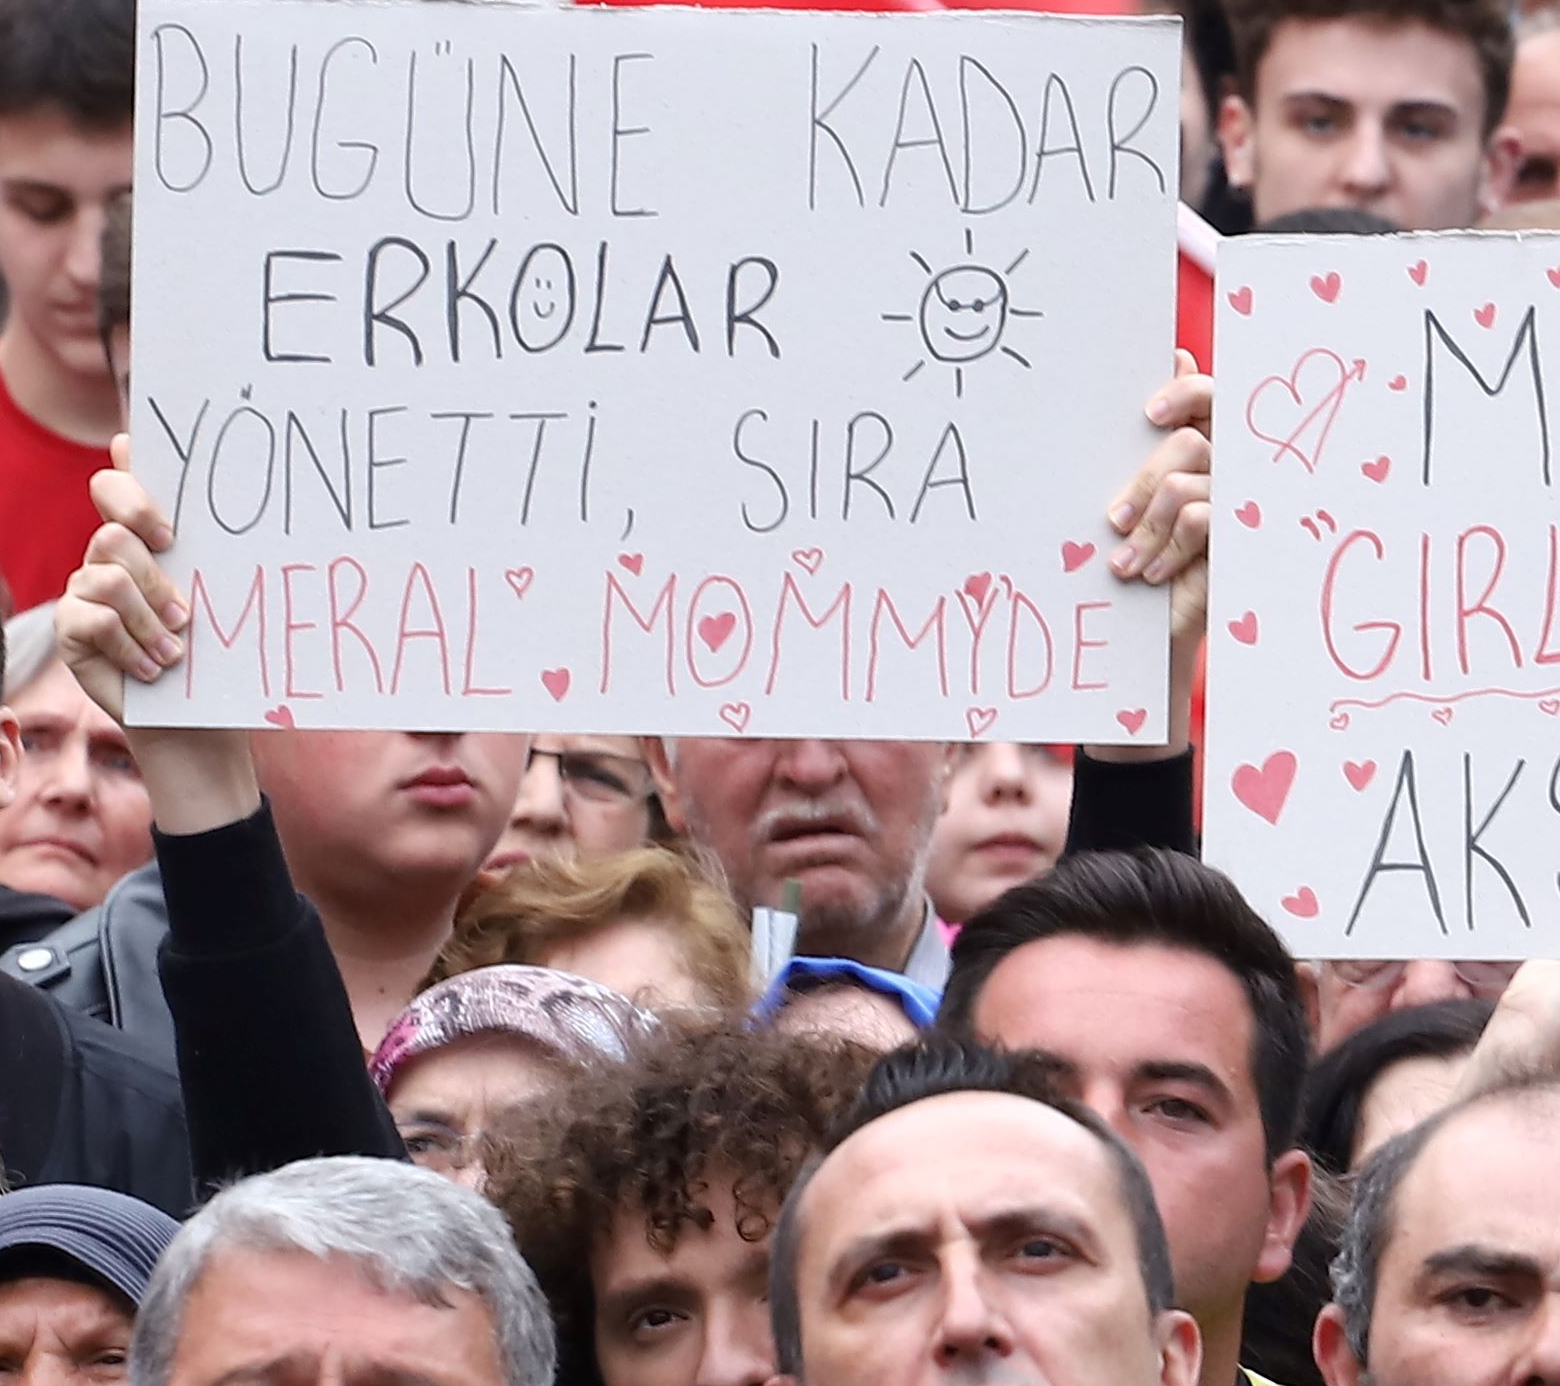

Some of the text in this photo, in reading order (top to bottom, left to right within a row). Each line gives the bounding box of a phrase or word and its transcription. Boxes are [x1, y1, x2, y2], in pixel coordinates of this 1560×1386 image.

[149, 23, 1167, 221] BUGÜNE KADAR
[262, 236, 782, 366] ERKOLAR
[147, 383, 978, 540] YÖNETTİ, SIRA
[185, 554, 513, 700] MERAL
